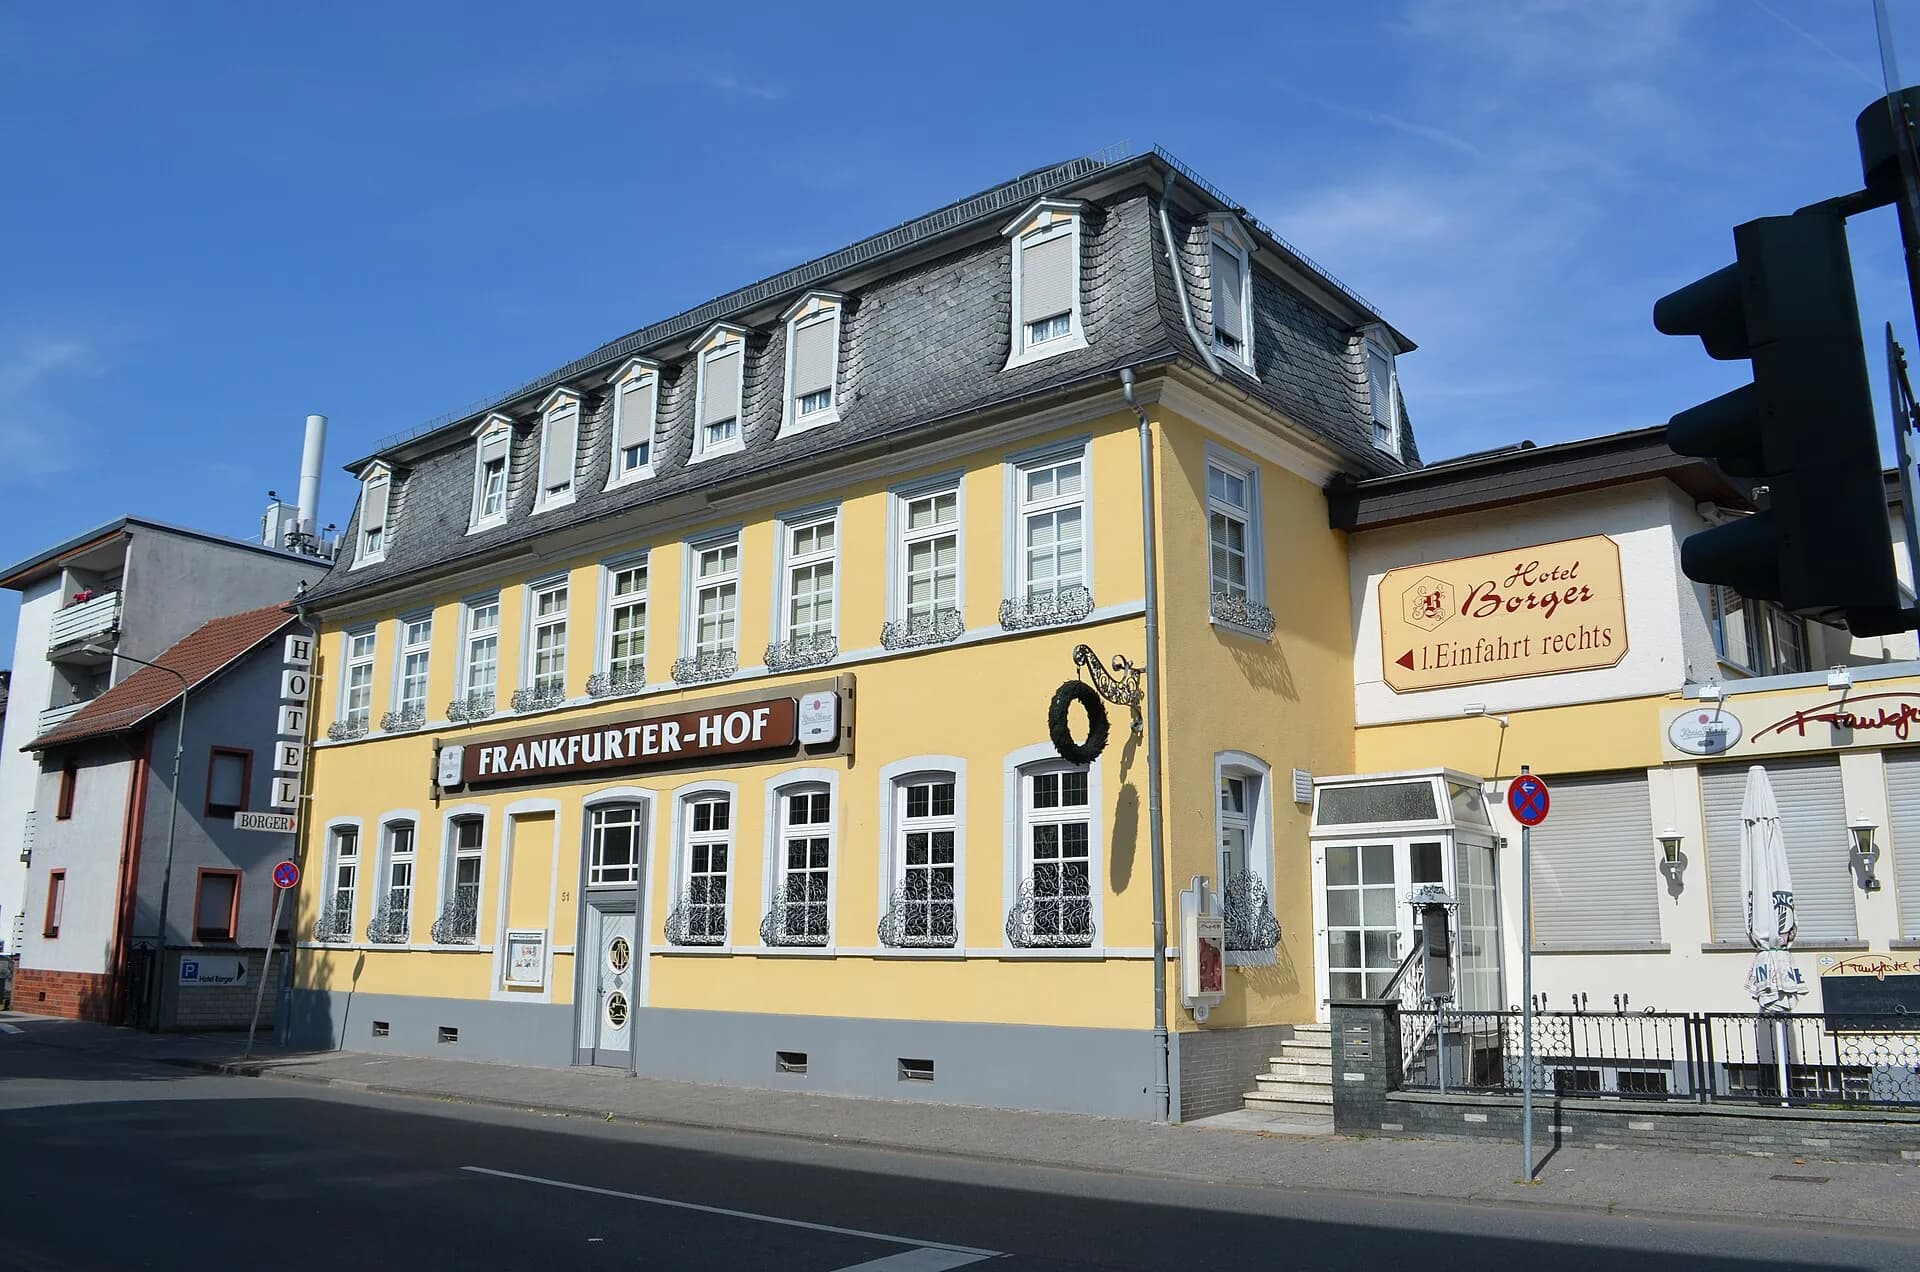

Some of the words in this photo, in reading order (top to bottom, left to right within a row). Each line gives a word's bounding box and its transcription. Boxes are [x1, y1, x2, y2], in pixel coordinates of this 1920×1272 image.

[1503, 560, 1579, 588] Hotel
[1461, 580, 1594, 619] Borger
[1542, 625, 1612, 655] rechts
[281, 639, 310, 803] HOTEL
[478, 706, 770, 776] FRANKFURTER-HOF
[241, 813, 288, 830] BORGER
[561, 890, 570, 902] 51
[185, 964, 195, 977] P
[216, 976, 234, 984] Borger
